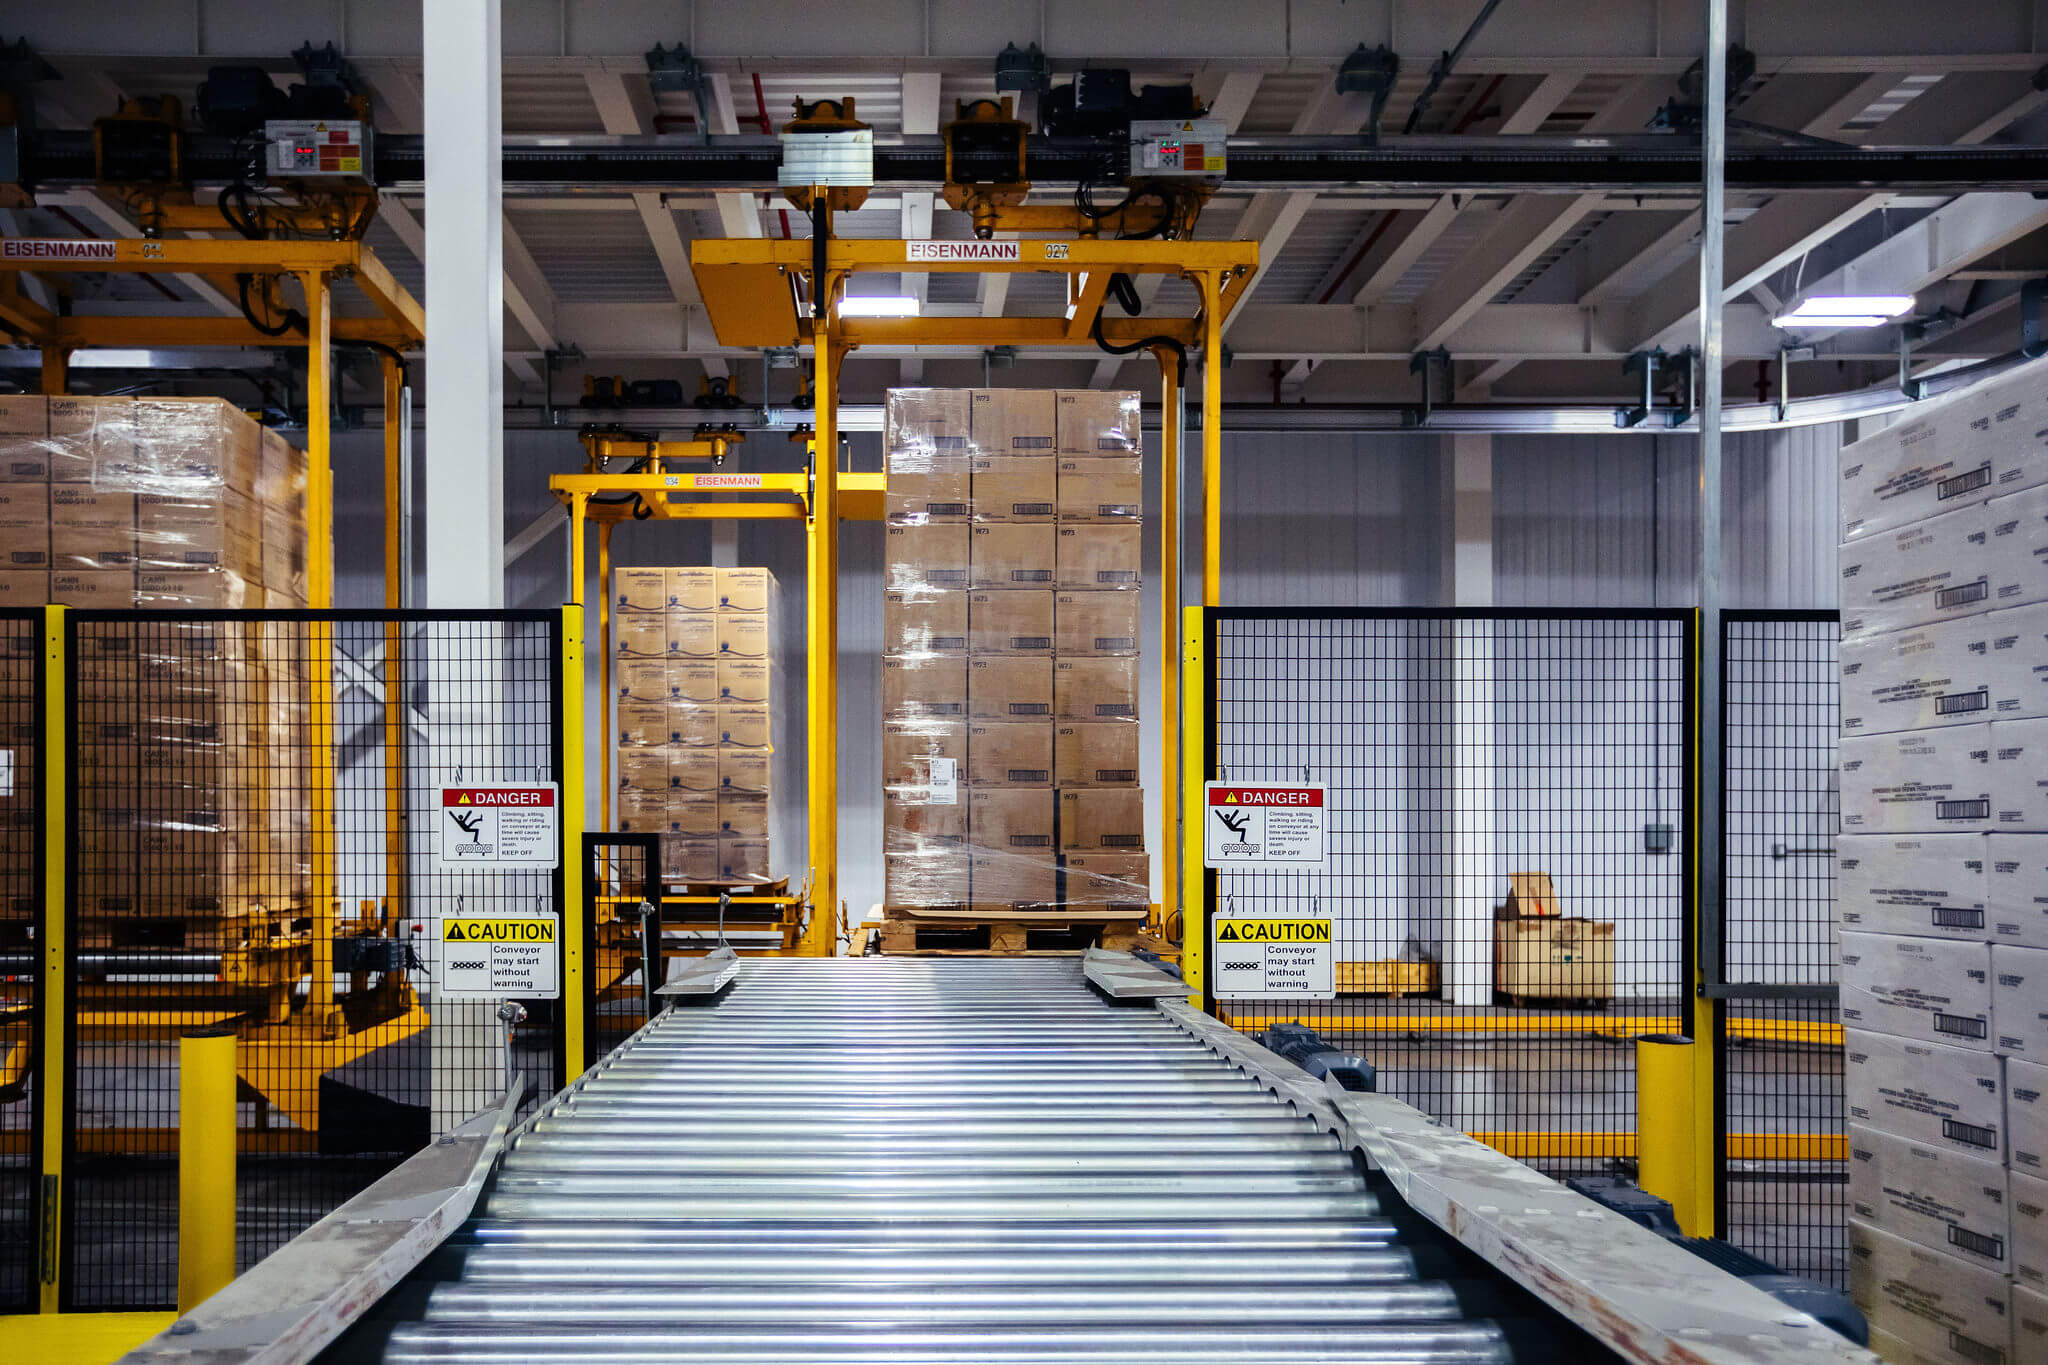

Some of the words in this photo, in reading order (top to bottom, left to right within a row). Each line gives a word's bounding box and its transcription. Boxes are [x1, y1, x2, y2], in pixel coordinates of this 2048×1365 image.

[4, 242, 114, 257] EISENMANN
[911, 244, 1017, 258] EISENMANN
[1046, 244, 1068, 259] 027
[695, 476, 760, 486] EISENMANN
[475, 792, 541, 805] DANGER
[1242, 792, 1310, 805] DANGER
[468, 923, 553, 940] CAUTION
[1241, 923, 1329, 940] CAUTION
[493, 945, 541, 956] Conveyor
[1267, 945, 1317, 956] Conveyor
[493, 957, 514, 967] may
[517, 957, 539, 965] start
[1267, 957, 1288, 968] may
[1291, 957, 1315, 965] start
[493, 968, 530, 976] without
[1267, 968, 1306, 976] without
[493, 979, 533, 990] warning
[1267, 979, 1309, 990] warning
